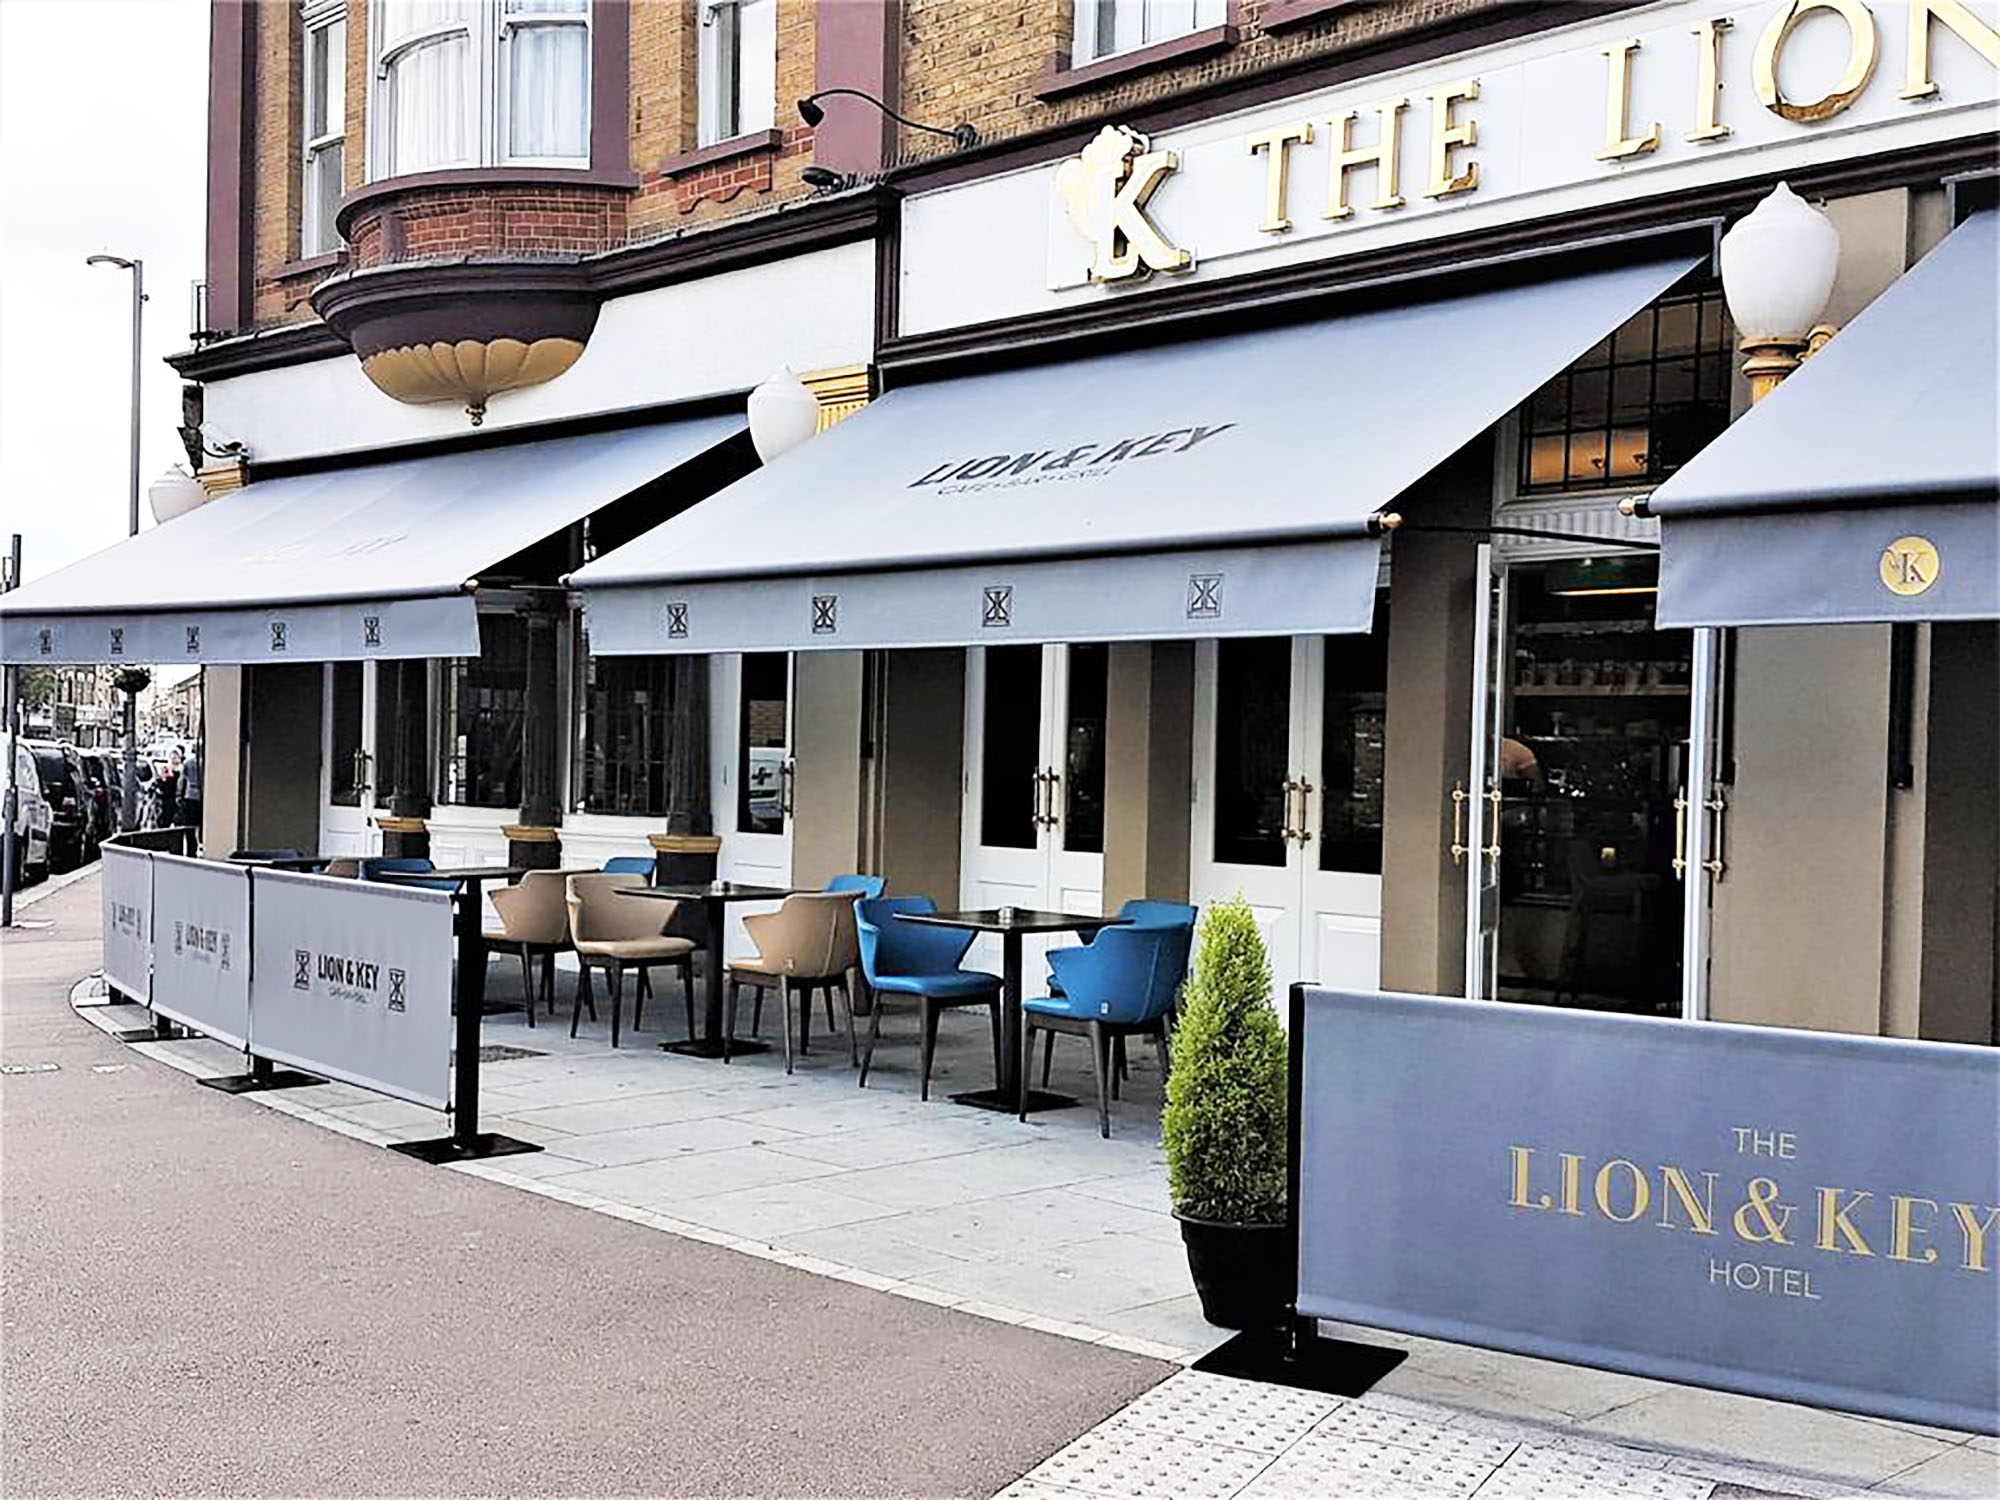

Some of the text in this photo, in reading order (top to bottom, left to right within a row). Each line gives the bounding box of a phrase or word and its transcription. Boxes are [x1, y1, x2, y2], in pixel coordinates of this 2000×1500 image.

[1247, 0, 2000, 234] THE LION
[906, 449, 1052, 489] LION
[1040, 443, 1099, 472] &
[1090, 422, 1239, 467] KEY
[317, 953, 380, 993] LION & KEY
[1730, 1126, 1798, 1160] THE
[1507, 1145, 2000, 1272] LION & KEY
[1708, 1257, 1823, 1300] HOTEL
